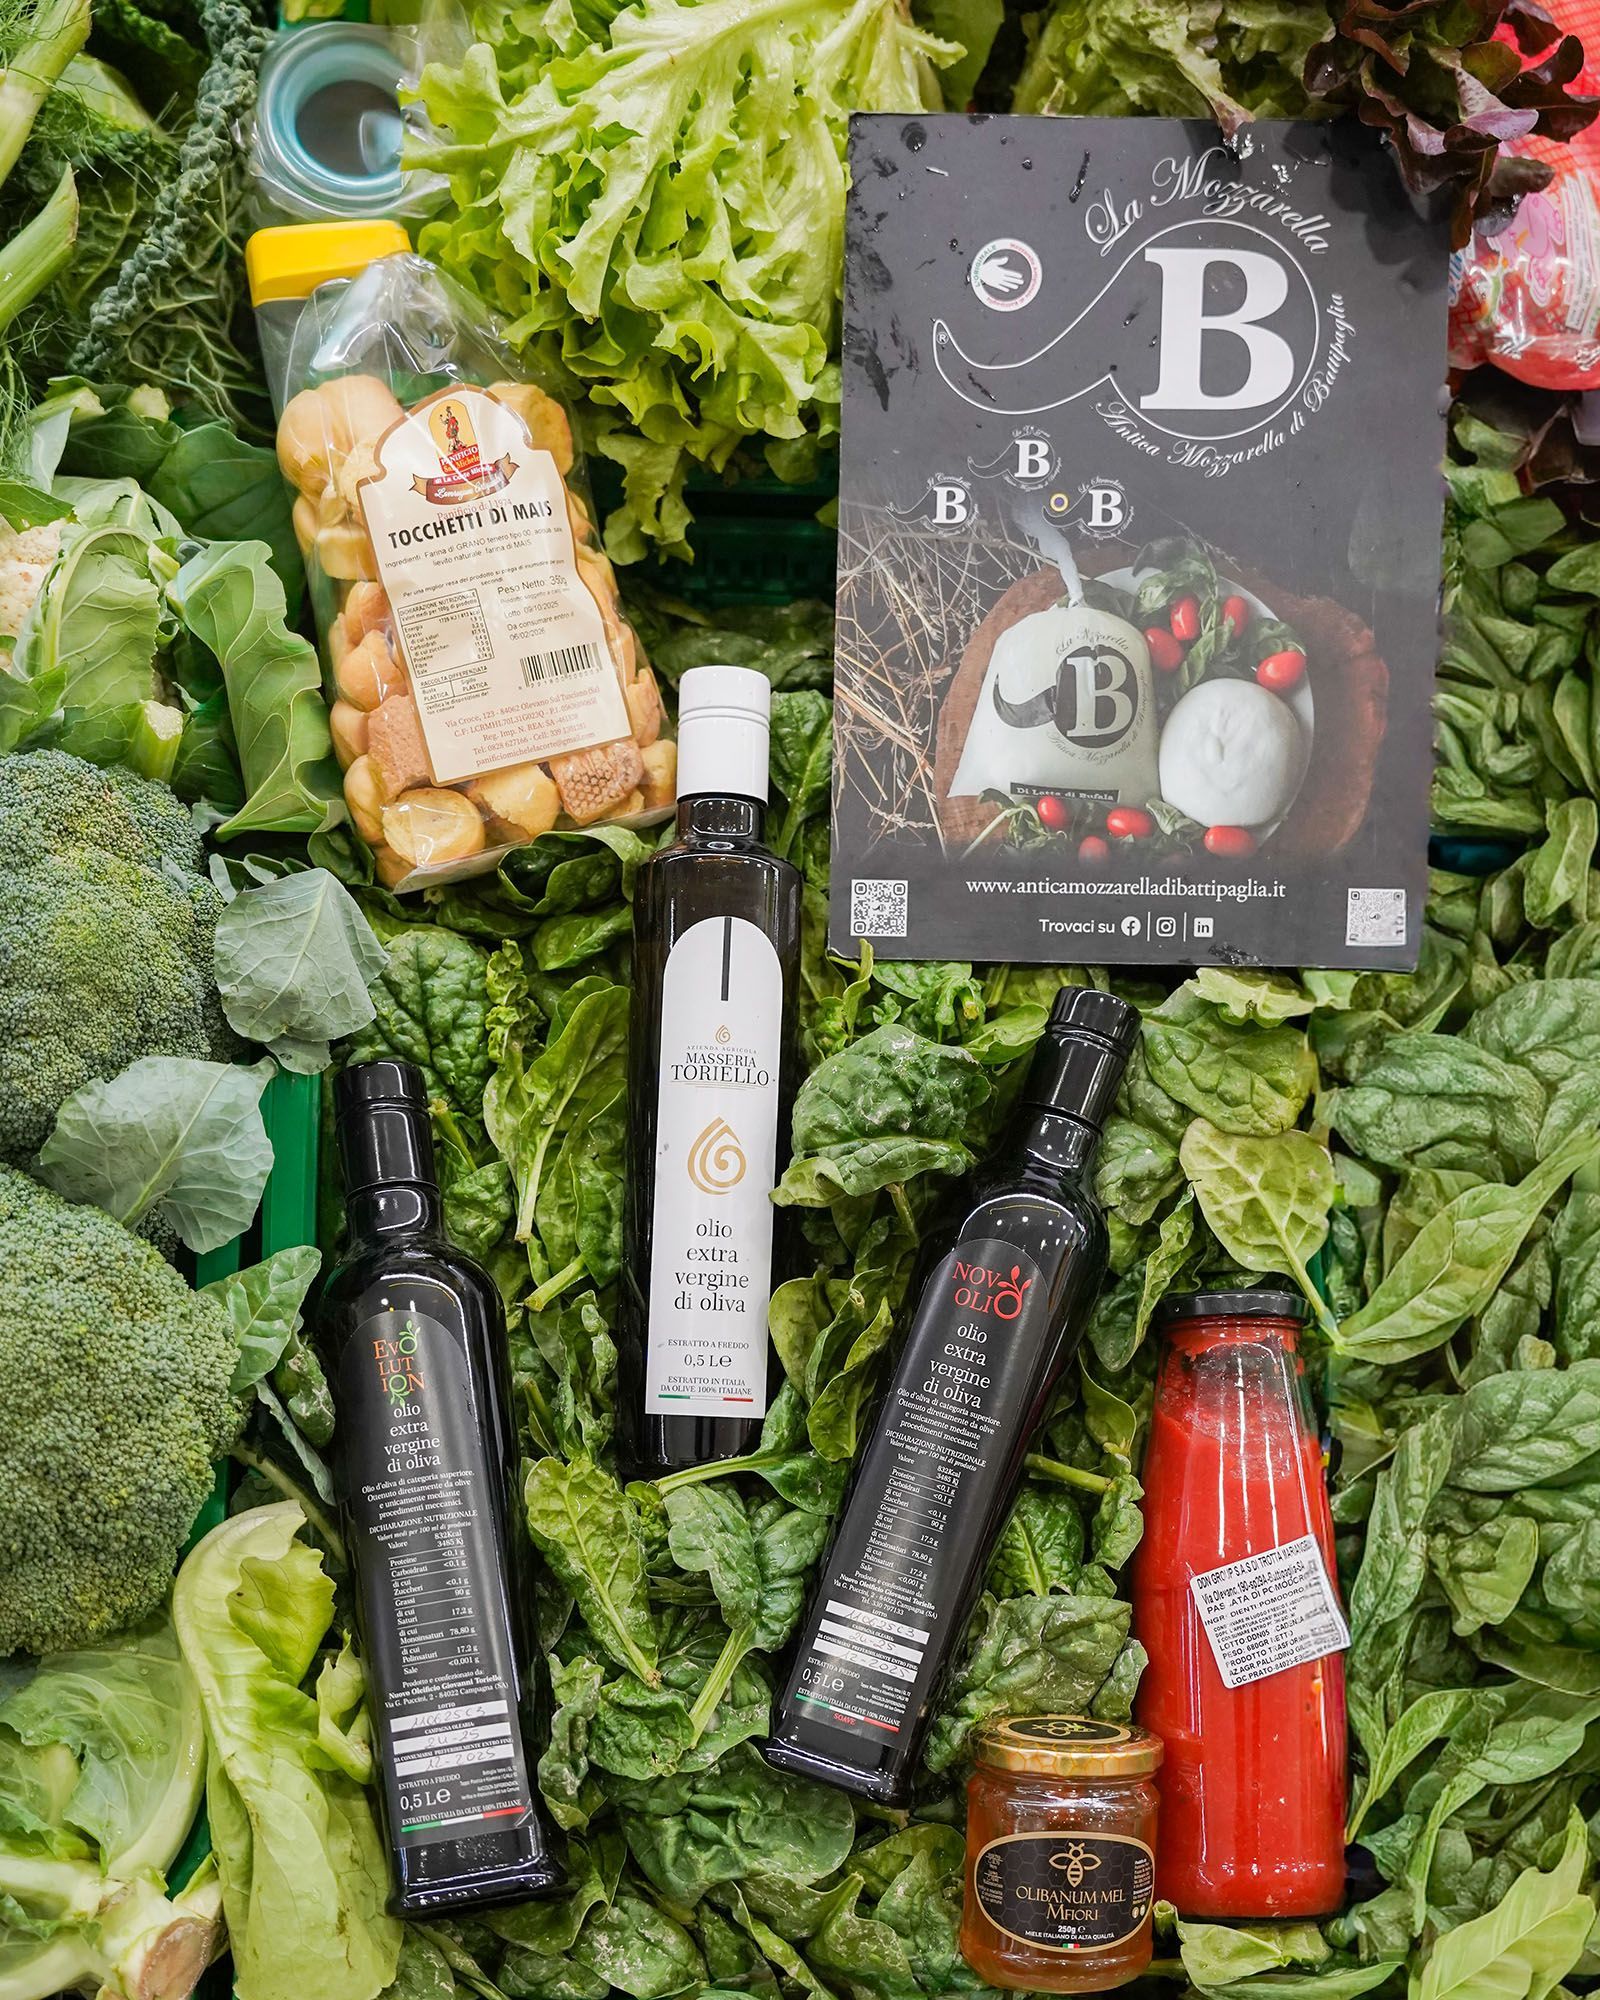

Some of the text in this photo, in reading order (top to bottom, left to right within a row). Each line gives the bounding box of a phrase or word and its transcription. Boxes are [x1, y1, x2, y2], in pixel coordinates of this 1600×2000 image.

[1085, 147, 1331, 256] La Mozzarella
[1140, 247, 1293, 409] B
[1096, 293, 1356, 478] Antica Mozzarella di Battipaglia
[1014, 439, 1050, 478] B
[932, 486, 967, 524] B
[1087, 489, 1124, 527] B
[388, 500, 552, 549] TOCCHETTI DI MAIS
[437, 509, 477, 523] Panificio
[455, 537, 486, 551] GRANO
[497, 584, 520, 595] Peso
[506, 623, 518, 632] Da
[518, 616, 553, 629] consumare
[553, 613, 570, 621] entro
[1066, 655, 1133, 737] B
[444, 719, 458, 728] Via
[482, 710, 496, 720] 123
[520, 699, 550, 711] Olevano
[966, 877, 1286, 903] www.anticamozzarelladibattipaglia.it
[1039, 918, 1116, 934] Trovaci su
[721, 1046, 757, 1054] AGRICOLA
[685, 1052, 757, 1068] MASSERIA
[671, 1064, 769, 1086] TORIELLO
[696, 1218, 733, 1238] olio
[686, 1247, 738, 1263] extra
[675, 1269, 749, 1292] vergine
[674, 1290, 746, 1313] di oliva
[957, 1322, 988, 1344] olio
[668, 1338, 710, 1348] ESTRATTO
[717, 1341, 750, 1350] FREDDO
[684, 1354, 705, 1367] 0,5
[944, 1343, 986, 1366] extra
[668, 1376, 746, 1386] ESTRATTO IN ITALIA
[930, 1359, 991, 1389] vergine
[660, 1384, 751, 1395] DA OLIVE 100% ITALIANE
[923, 1376, 981, 1409] di oliva
[393, 1403, 421, 1418] olio
[896, 1387, 910, 1398] Olio
[909, 1391, 931, 1404] d'oliva
[931, 1397, 939, 1406] di
[938, 1401, 969, 1416] categoria
[898, 1397, 995, 1435] Ottenuto direttamente da olive
[389, 1421, 429, 1437] extra
[899, 1420, 979, 1450] procedimenti meccanici.
[910, 1412, 949, 1430] unicamente
[949, 1425, 981, 1441] mediante
[383, 1437, 440, 1456] vergine
[885, 1429, 987, 1468] DICHIARAZIONE NUTRIZIONALE
[928, 1451, 940, 1459] 100
[387, 1454, 441, 1473] di oliva
[367, 1478, 471, 1503] Ottenuto direttamente da olive
[375, 1481, 398, 1491] d'oliva
[398, 1478, 406, 1486] di
[406, 1473, 439, 1485] categoria
[384, 1495, 426, 1508] unicamente
[426, 1490, 461, 1501] mediante
[378, 1503, 424, 1521] procedimenti
[368, 1509, 478, 1535] DICHIARAZIONE NUTRIZIONALE
[912, 1597, 935, 1610] Toriello
[1250, 1590, 1261, 1600] DI
[473, 1674, 502, 1684] Toriello
[802, 1667, 822, 1685] 0,5
[400, 1793, 423, 1811] 0,5
[1015, 1885, 1126, 1905] OLIBANUM MEL
[1046, 1902, 1098, 1921] MFIORI
[1025, 1930, 1043, 1938] MIELE
[1043, 1931, 1070, 1940] ITALIANO
[1057, 1924, 1076, 1935] 250g
